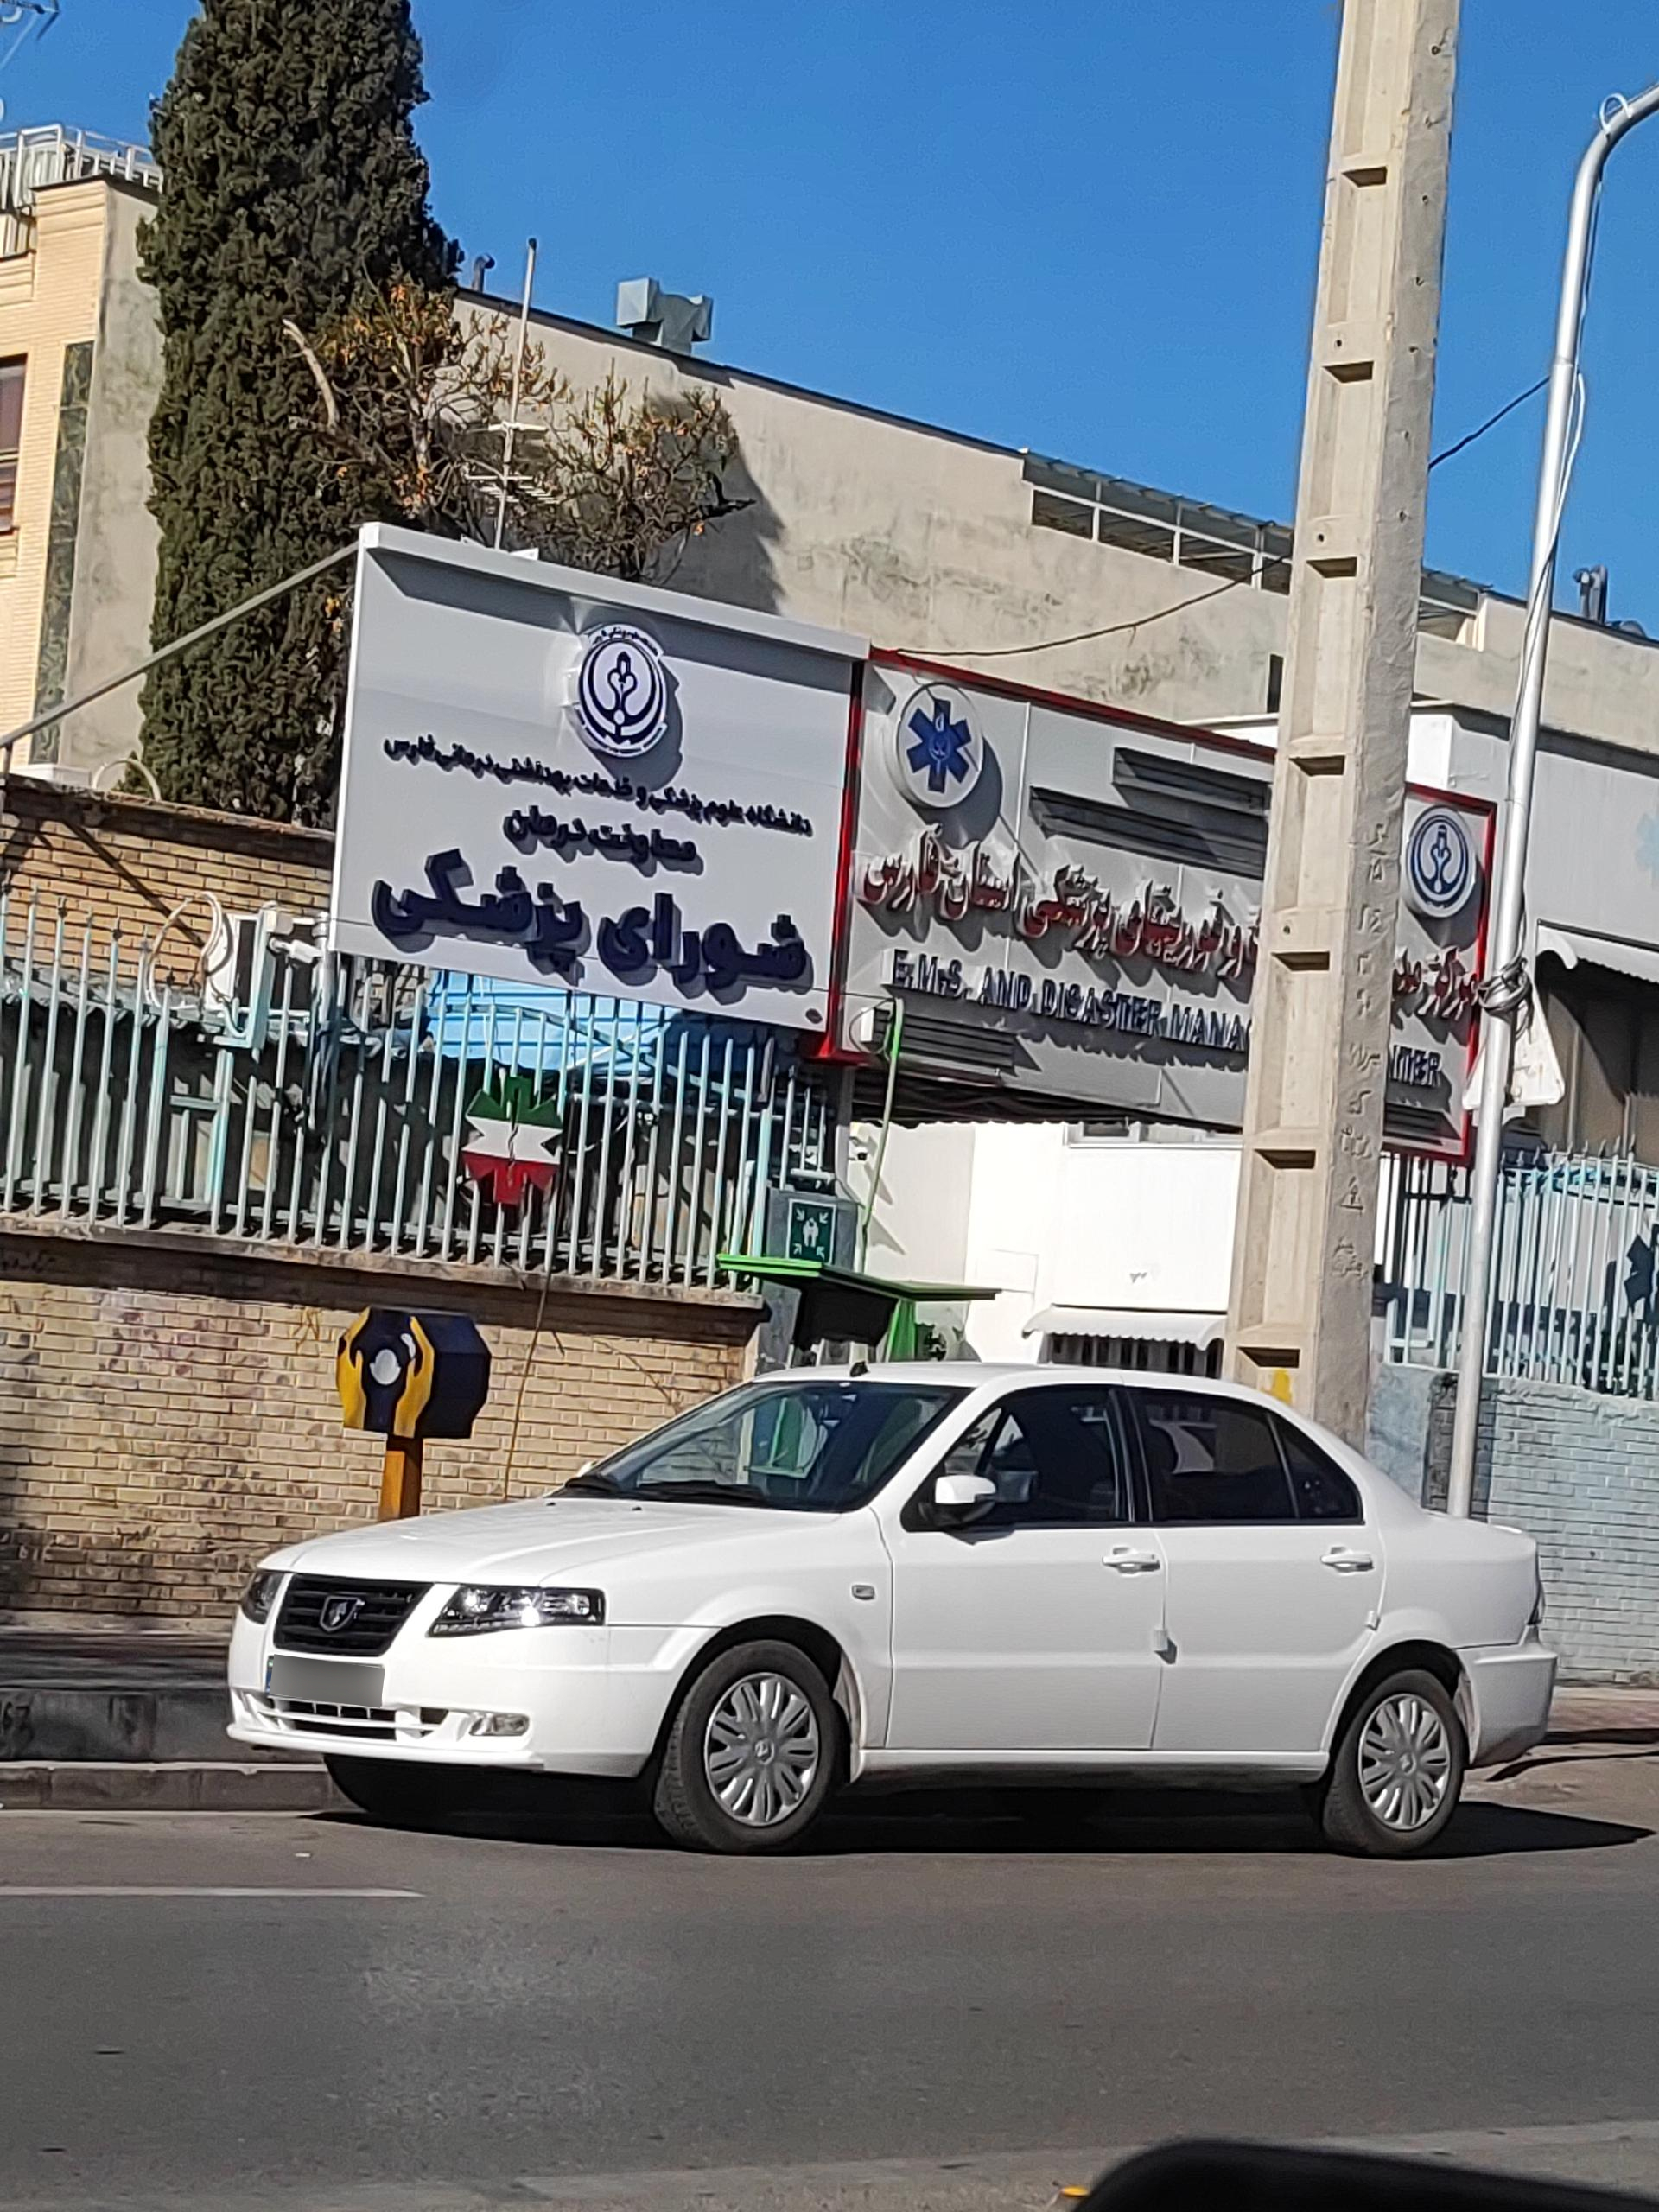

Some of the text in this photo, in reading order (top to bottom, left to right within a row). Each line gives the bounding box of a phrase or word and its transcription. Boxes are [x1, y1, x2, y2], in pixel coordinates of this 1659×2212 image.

[383, 734, 436, 761] فارس
[574, 772, 632, 801] خدمات
[634, 785, 648, 810] و
[649, 787, 702, 823] پزشکی
[503, 804, 698, 866] معاونت درمان
[702, 800, 746, 827] علوم
[745, 804, 812, 836] دانشگاه
[862, 823, 943, 912] فارس
[938, 838, 1023, 923] استان
[372, 848, 809, 990] شورای پزشکی
[1015, 862, 1113, 961] پزشکی
[980, 965, 1033, 1011] AND
[1042, 977, 1164, 1038] DISASTER
[1167, 1002, 1254, 1052] MANA
